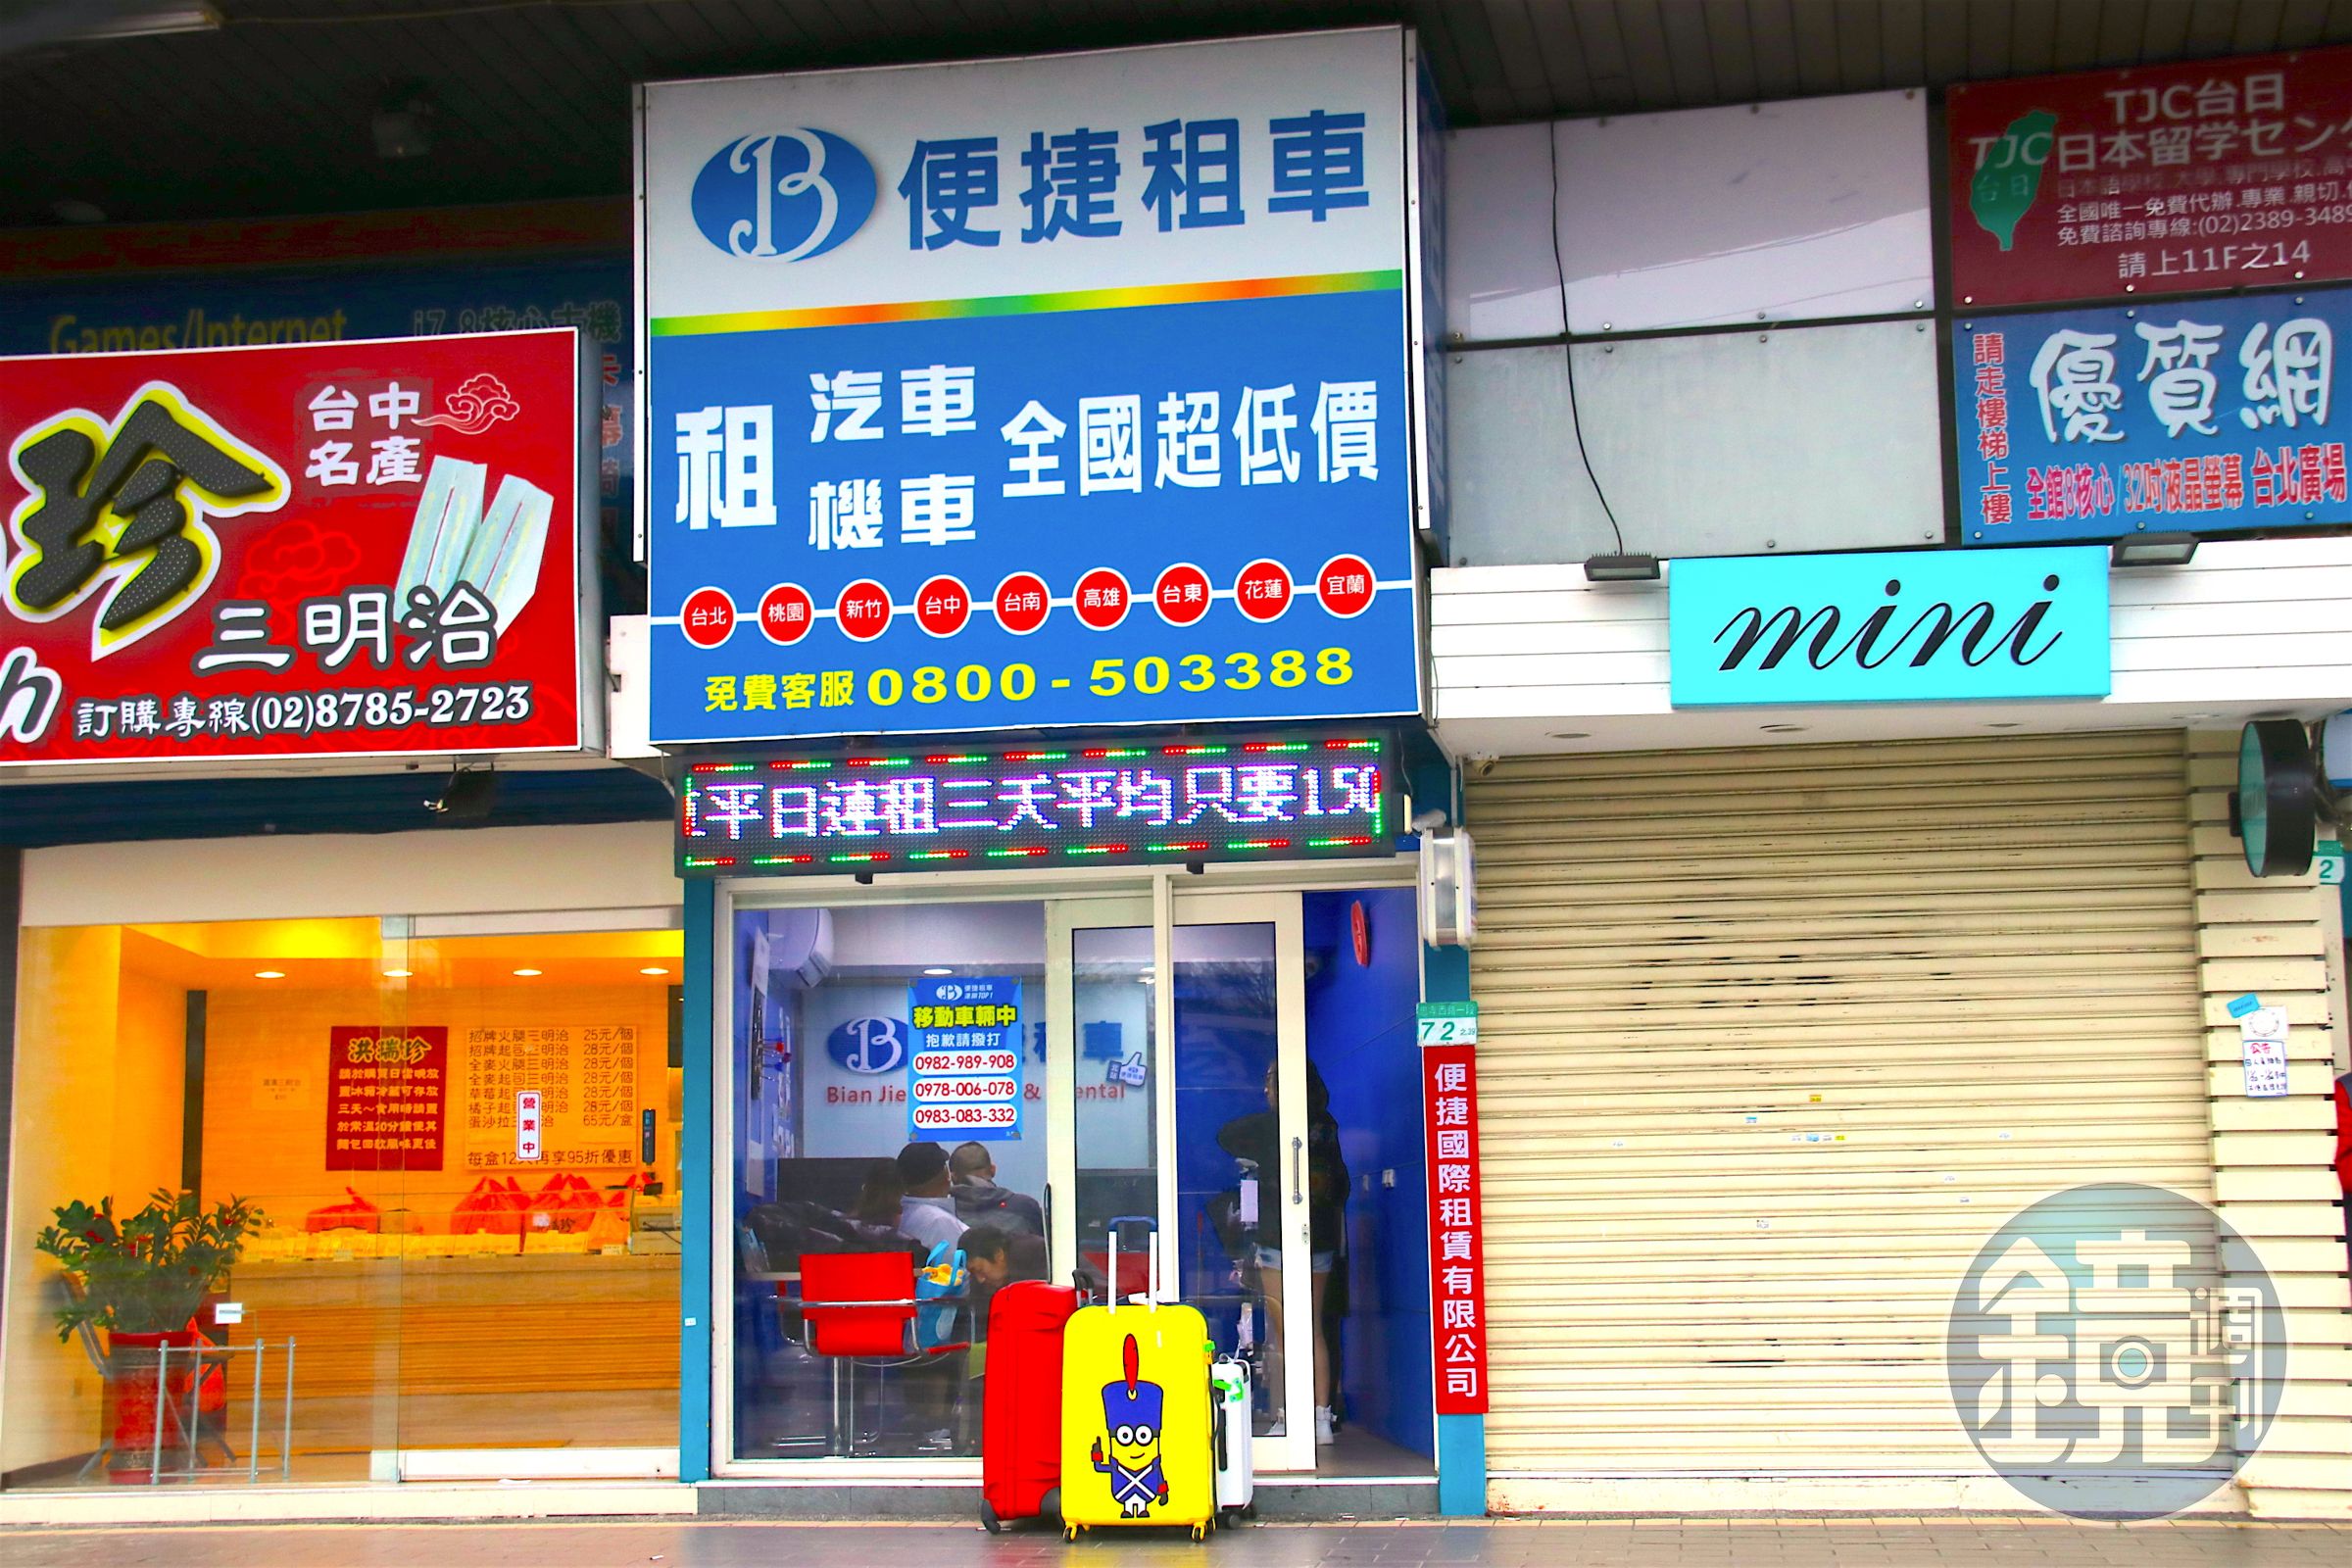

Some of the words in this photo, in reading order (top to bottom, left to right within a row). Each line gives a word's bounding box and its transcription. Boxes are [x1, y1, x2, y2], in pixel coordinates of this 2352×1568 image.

[2105, 73, 2285, 124] TJC台日
[1969, 132, 2055, 171] TJC
[2059, 117, 2352, 172] 日本留学セン
[898, 110, 1371, 251] 便捷租車
[2030, 318, 2333, 444] 優質網
[308, 381, 421, 431] 台中
[808, 366, 976, 443] 汽車
[1001, 380, 1380, 498] 全國超低價
[1973, 332, 2013, 526] 請走樓梯上樓
[306, 437, 423, 486] 名產
[675, 405, 777, 530] 租
[2251, 442, 2348, 507] 台北廣場
[808, 474, 976, 551] 機車
[1004, 592, 1041, 612] 台南
[1083, 587, 1121, 609] 高雄
[1162, 583, 1202, 605] 台東
[1245, 578, 1284, 600] 花蓮
[1326, 574, 1366, 595] 宜蘭
[691, 607, 727, 626] 台北
[767, 602, 805, 622] 桃園
[846, 599, 882, 618] 新竹
[924, 594, 961, 615] 台中
[1713, 574, 2064, 671] mini
[196, 588, 492, 670] 三明治
[705, 670, 856, 712] 免費客服
[76, 684, 530, 738] 訂購專線(02)8785-2723
[912, 1004, 1018, 1029] 移動車輛中
[1421, 1020, 1455, 1041] 72
[348, 1036, 433, 1064] 洪瑞珍
[925, 1032, 1002, 1049] 抱歉請撥打
[914, 1054, 1015, 1070] 0982-989-908
[826, 1085, 872, 1104] Bian
[1023, 1083, 1042, 1101] &
[1074, 1082, 1126, 1100] ental
[914, 1081, 1015, 1097] 0978-006-078
[522, 1097, 536, 1155] 營業中
[914, 1107, 1015, 1124] 0983-083-332
[467, 1149, 633, 1167] 每盒12再享95折優惠
[1434, 1062, 1479, 1398] 便捷國際租賃有限公司
